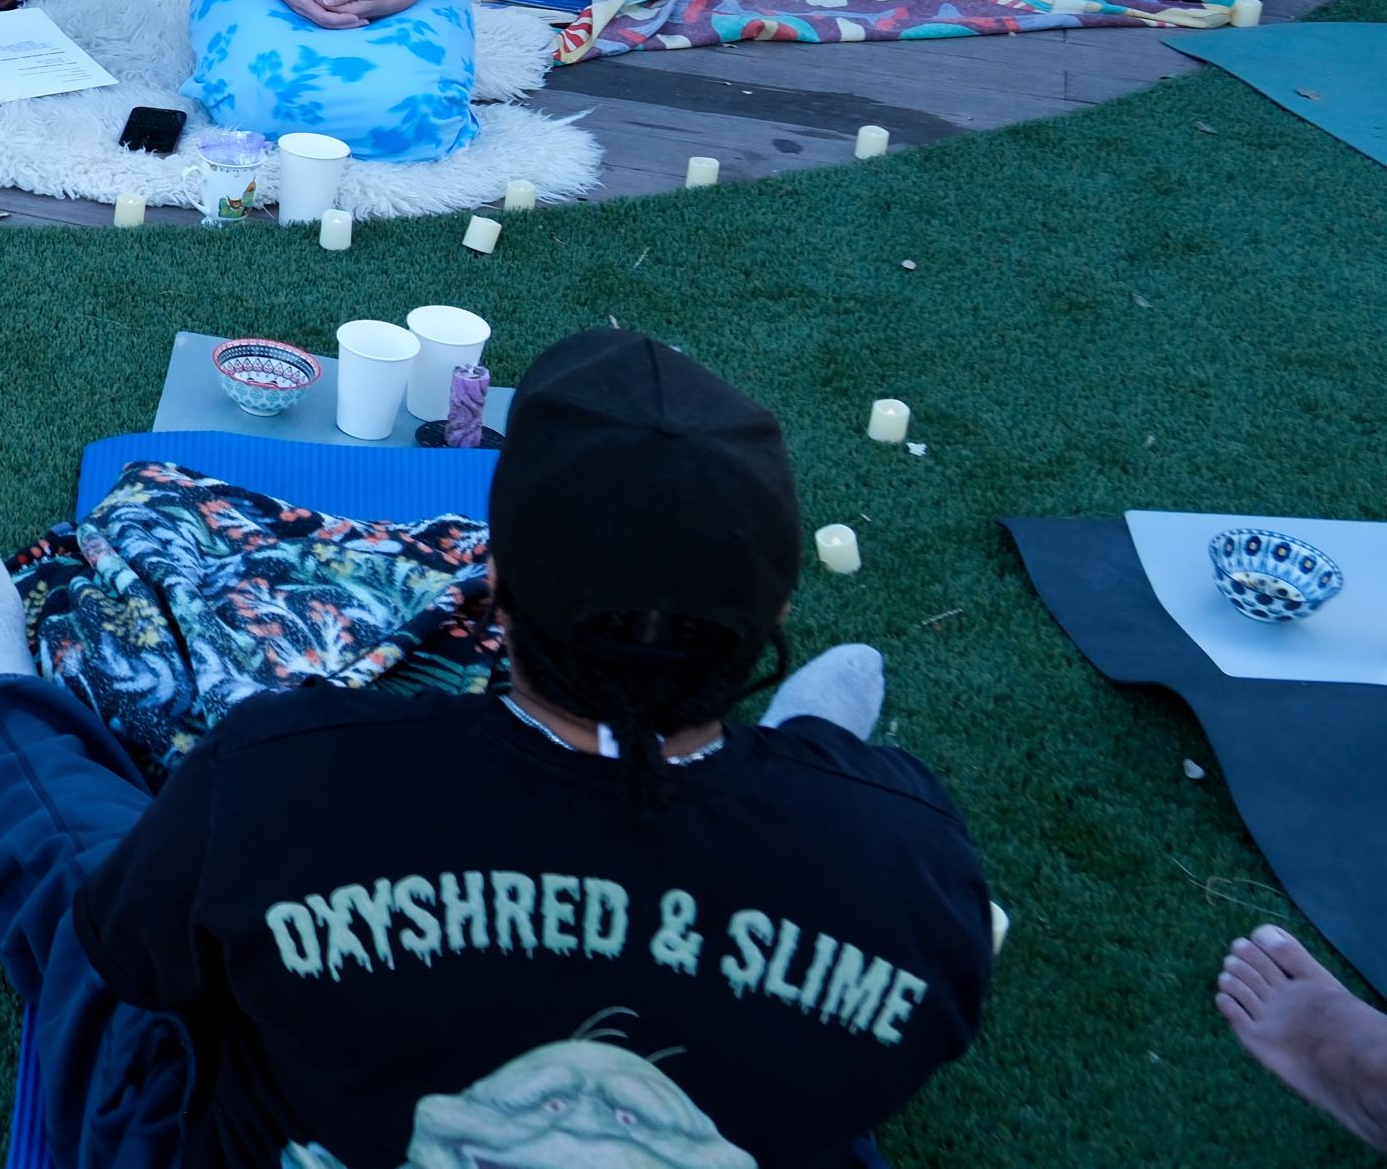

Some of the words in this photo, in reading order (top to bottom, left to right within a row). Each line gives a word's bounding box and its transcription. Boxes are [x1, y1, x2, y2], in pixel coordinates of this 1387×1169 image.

[265, 870, 629, 983] OXYSHRED
[649, 888, 704, 977] &
[720, 909, 928, 1047] SLIME
